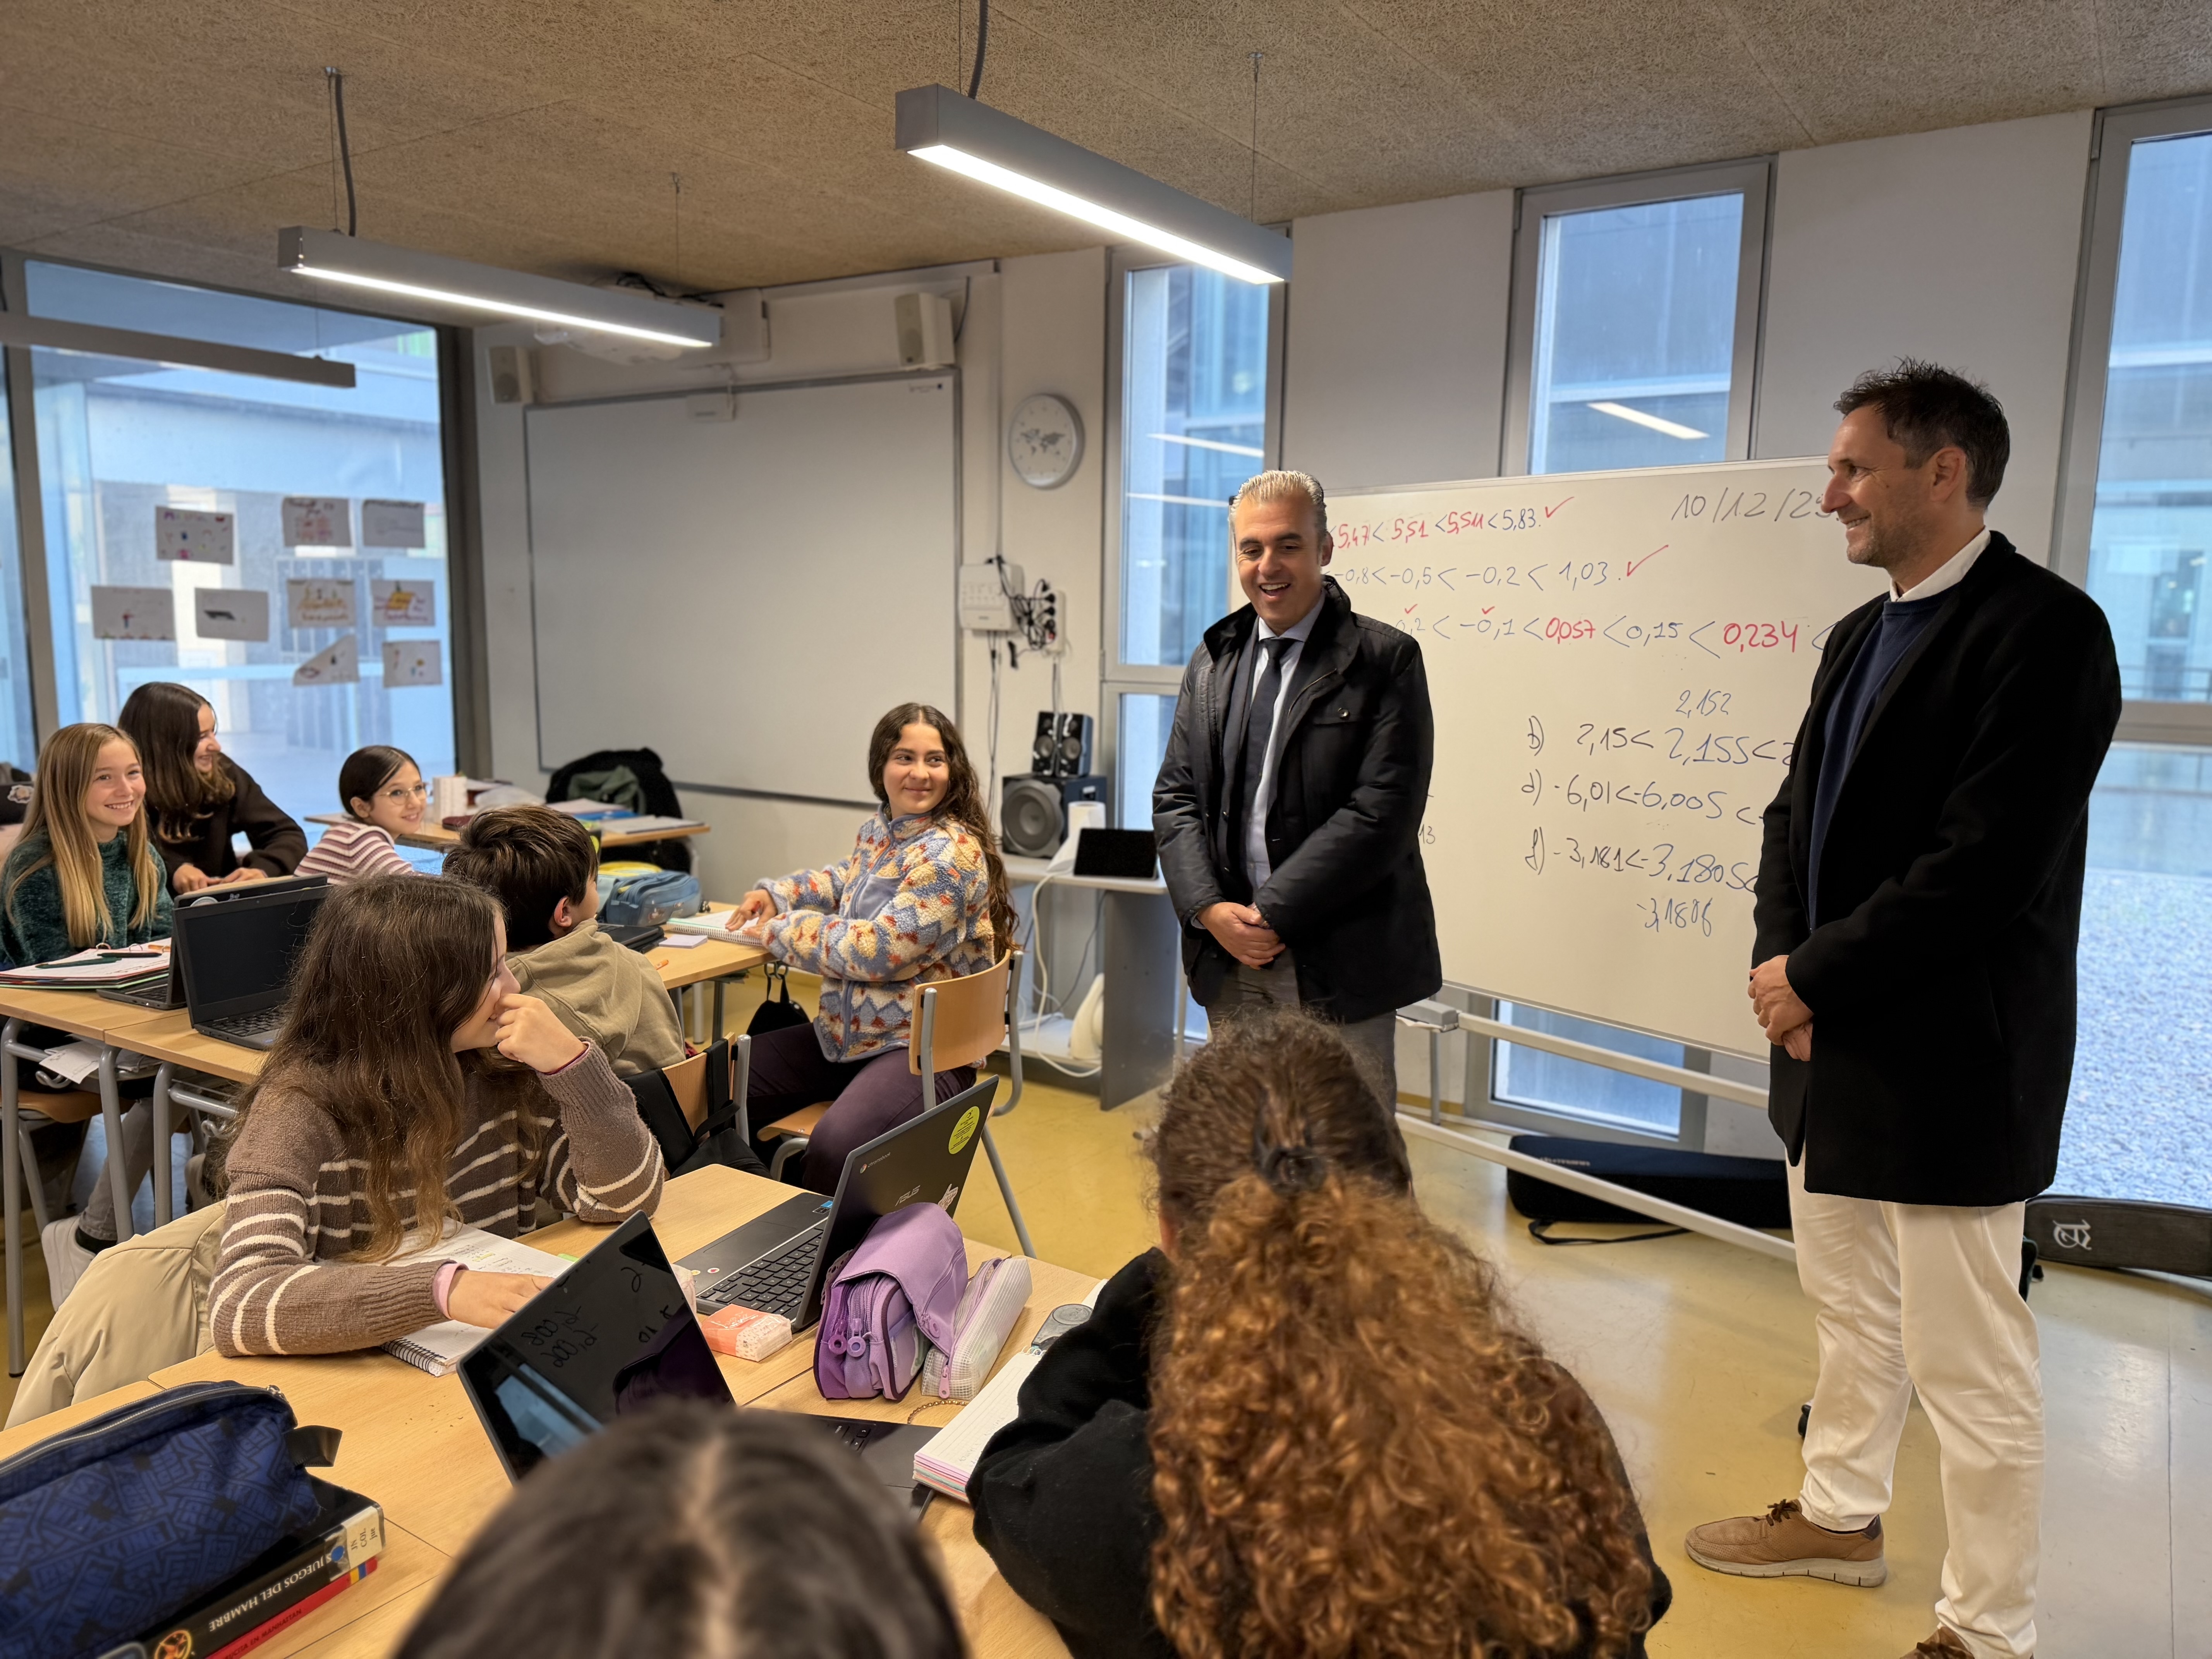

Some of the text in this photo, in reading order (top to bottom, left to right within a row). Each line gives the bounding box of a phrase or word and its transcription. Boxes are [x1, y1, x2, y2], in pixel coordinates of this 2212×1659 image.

[1391, 518, 1429, 543] 5,51
[1546, 617, 1596, 644] 0,057
[1626, 622, 1683, 646] 0,15
[1675, 689, 1731, 718] 2,152
[1577, 723, 1627, 756] 2,15
[1664, 727, 1750, 766] 2,155
[895, 1185, 921, 1207] ASUS
[209, 1556, 324, 1632] JUEGOS DEL HAMBRE
[261, 1609, 302, 1638] MANHATTAN
